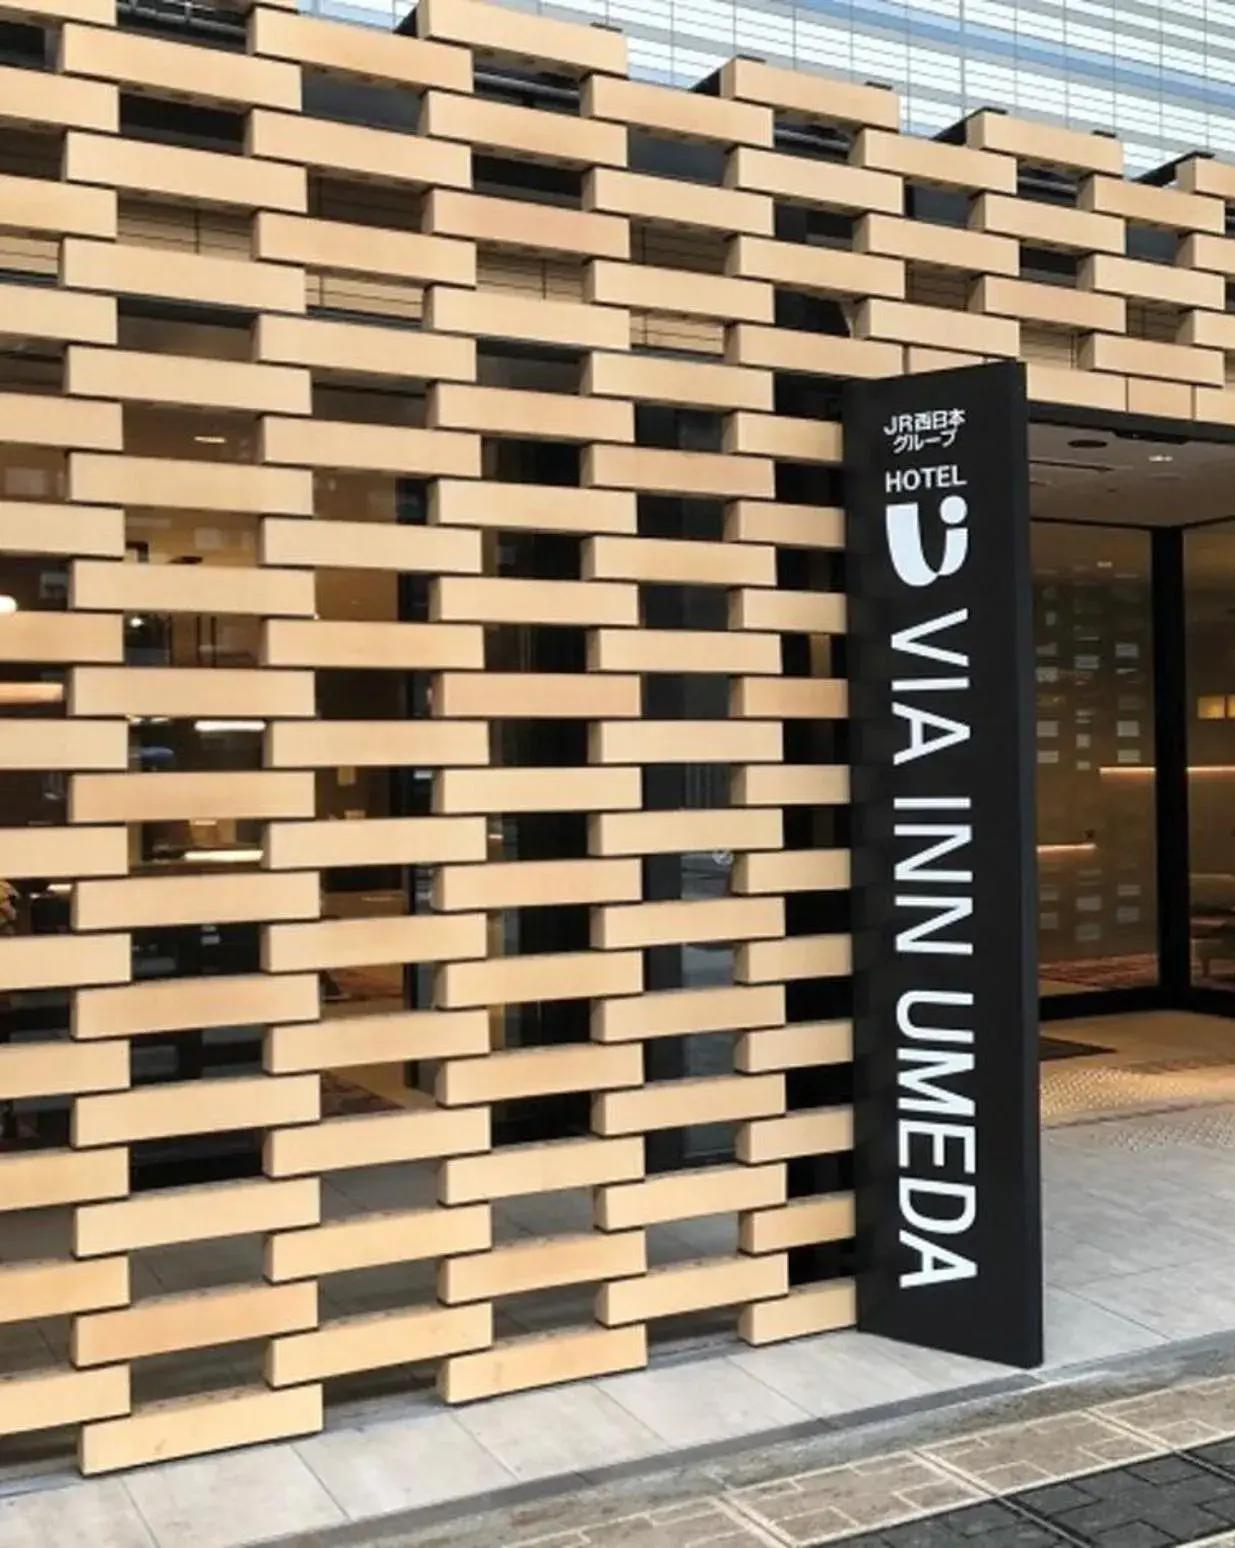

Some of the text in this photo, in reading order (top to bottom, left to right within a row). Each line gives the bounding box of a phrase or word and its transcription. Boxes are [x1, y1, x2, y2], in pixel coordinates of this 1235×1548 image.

[883, 408, 967, 436] JR西日本
[893, 427, 958, 454] グループ
[885, 464, 968, 493] HOTEL
[890, 607, 978, 1289] VIA INN UMEDA
